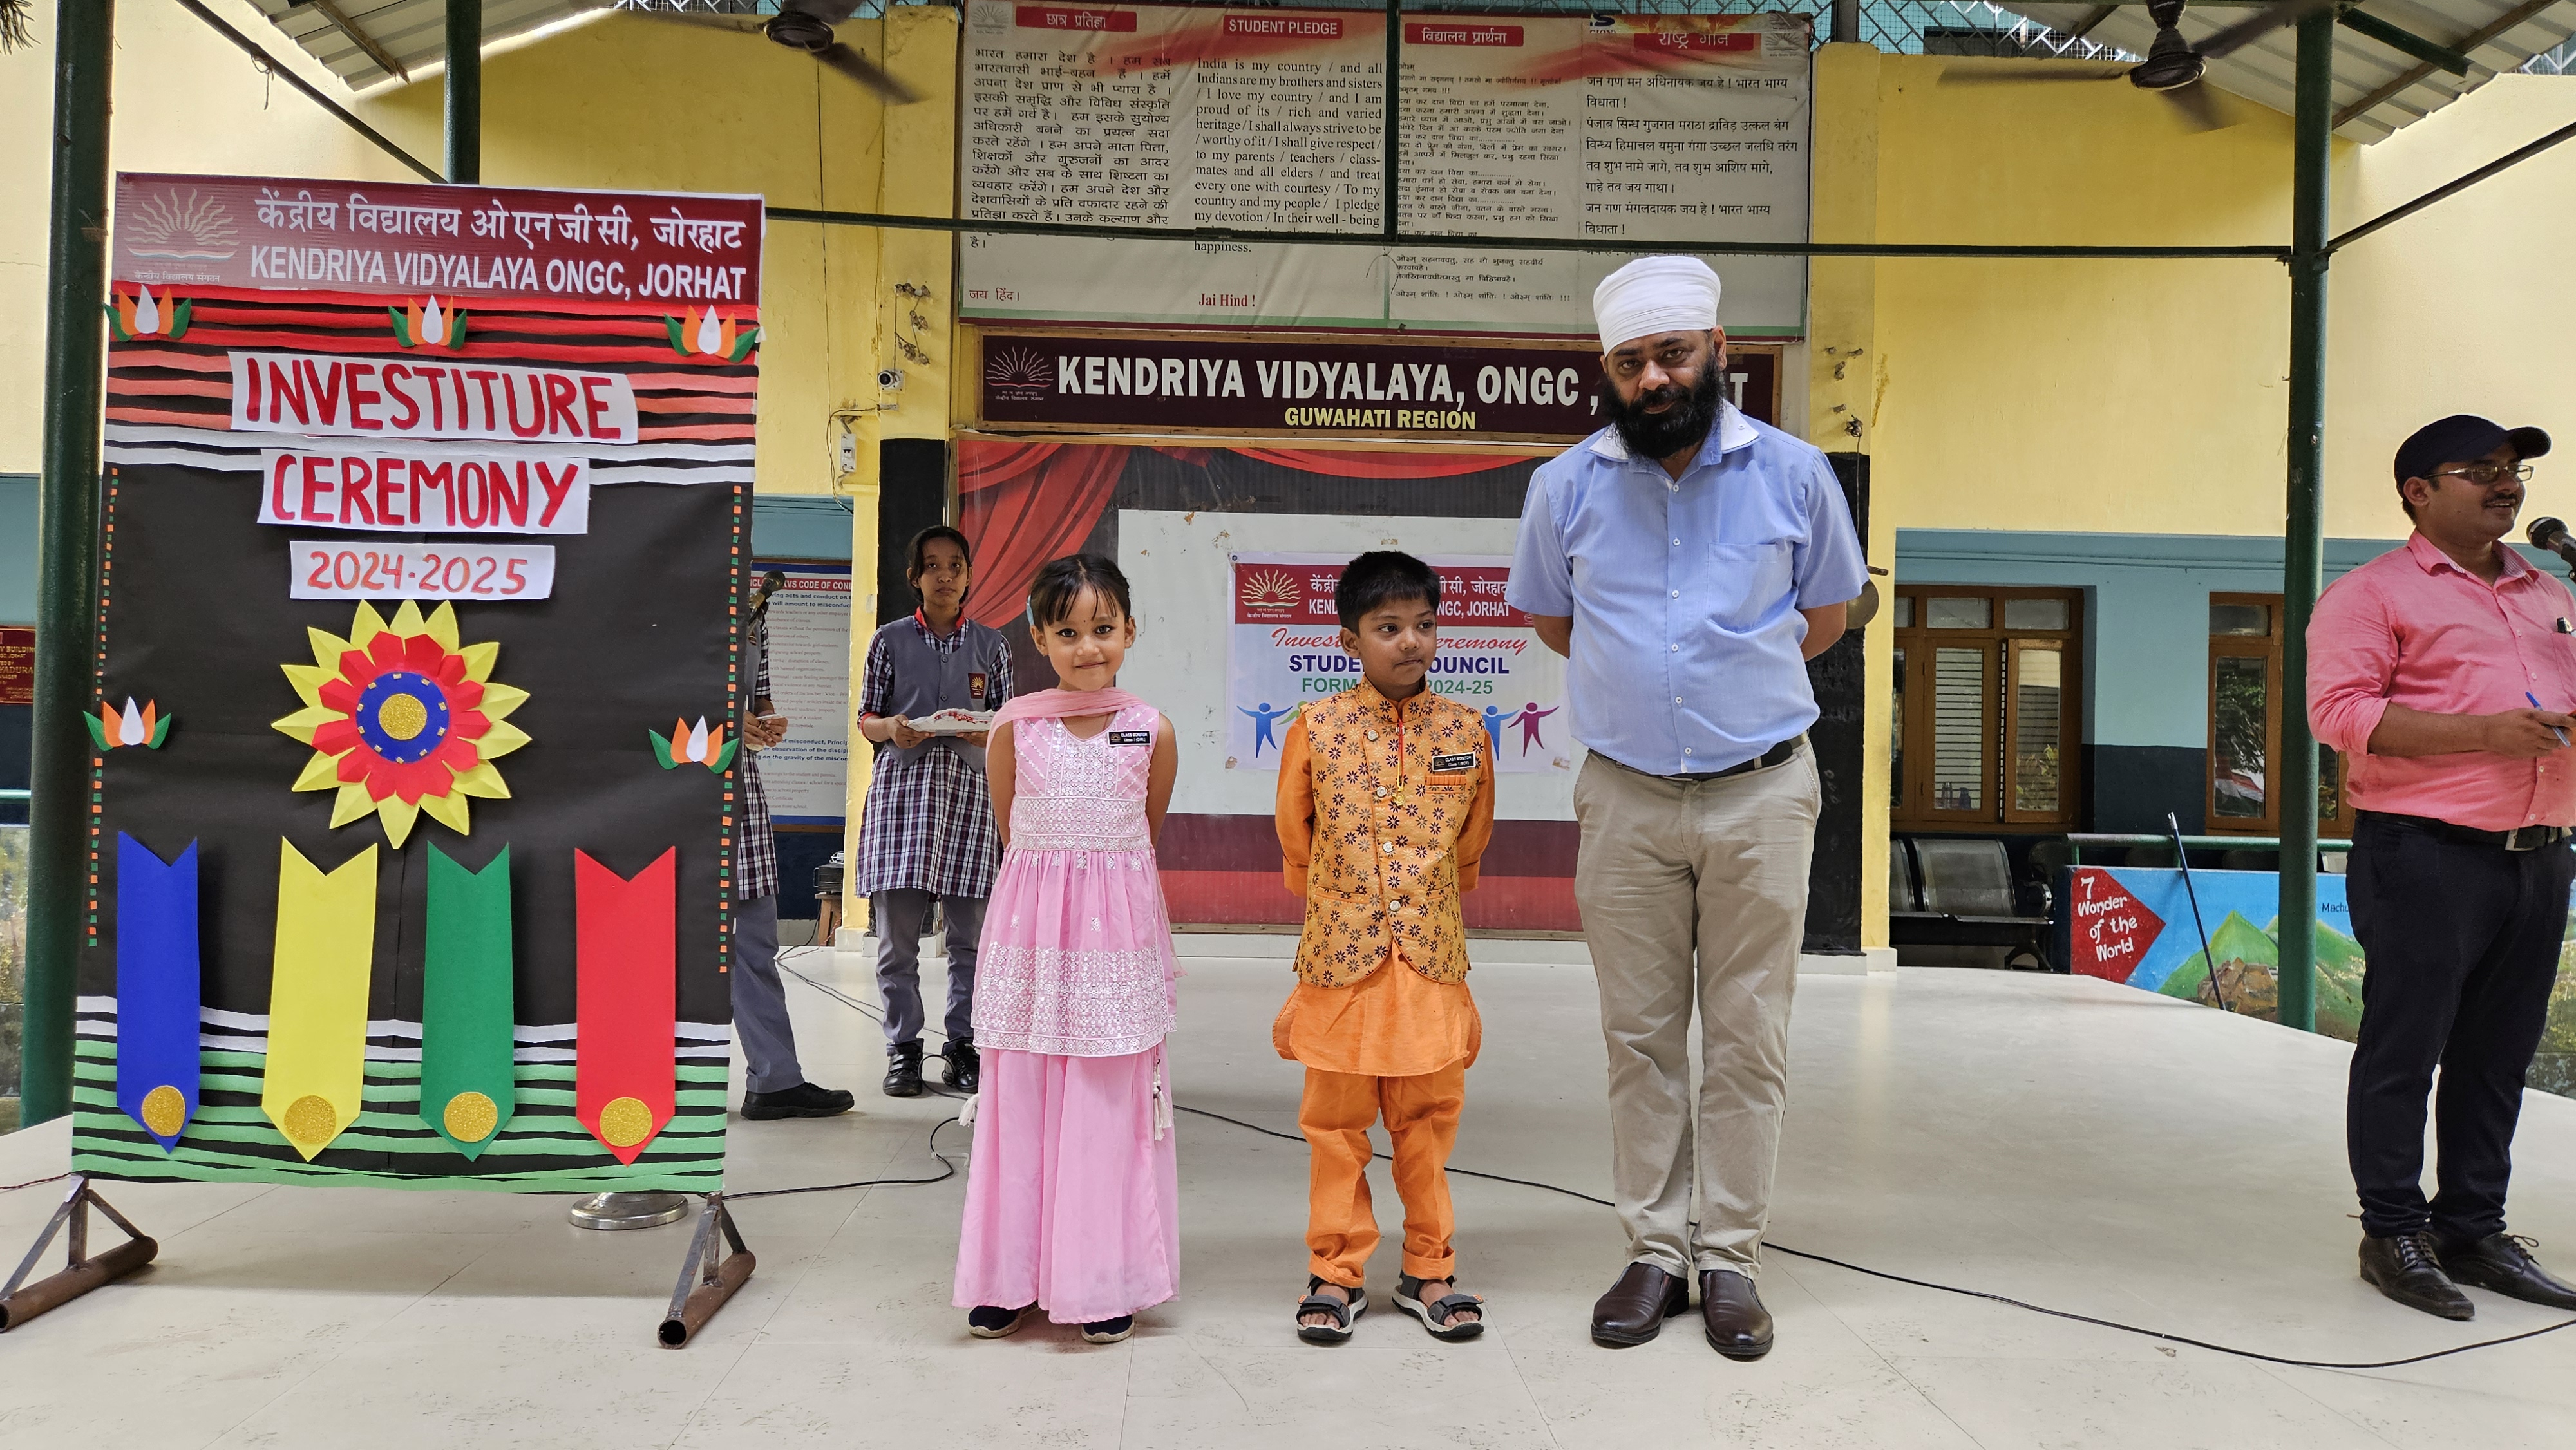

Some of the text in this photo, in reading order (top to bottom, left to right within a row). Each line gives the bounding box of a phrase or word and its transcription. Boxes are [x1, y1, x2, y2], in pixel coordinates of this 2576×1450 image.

[1046, 11, 1106, 29] छात्र प्रतिज्ञा
[1229, 19, 1338, 35] STUDENT PLEDGE
[1421, 27, 1507, 44] विद्यालय प्रार्थना
[1198, 72, 1382, 89] Indians are my brothers and sisters
[974, 91, 1171, 112] इसकी समृद्धि और विविध संस्कृति
[1197, 104, 1229, 116] proud
[1237, 104, 1251, 115] of
[1257, 104, 1269, 116] its
[1289, 106, 1311, 117] rich
[1318, 107, 1338, 118] and
[1346, 108, 1381, 119] varied
[1197, 118, 1240, 133] heritage
[1249, 120, 1252, 131] I
[1255, 120, 1280, 131] shall
[1283, 121, 1321, 135] always
[1323, 122, 1354, 133] strive
[1356, 124, 1367, 134] to
[1368, 123, 1381, 135] be
[1586, 137, 1798, 154] विन्ध्य हिमाचल यमुना गंगा उच्छल जलधि तरंग
[972, 148, 1170, 167] शिक्षकों और गुरुजनों का आदर
[1195, 166, 1227, 175] mates
[1234, 165, 1253, 176] and
[1260, 166, 1273, 176] all
[1280, 166, 1313, 178] elders
[1330, 168, 1349, 179] and
[1356, 170, 1380, 180] treat
[1195, 182, 1226, 193] every
[1230, 183, 1251, 191] one
[1255, 181, 1279, 192] with
[1284, 184, 1331, 196] courtesy
[1343, 184, 1358, 194] To
[1363, 187, 1380, 198] my
[971, 192, 1168, 210] देशवासियों के प्रति वफादार रहने की
[1195, 197, 1236, 209] country
[1240, 196, 1260, 207] and
[1264, 199, 1281, 211] my
[1284, 197, 1320, 211] people
[1336, 198, 1339, 209] I
[1343, 198, 1380, 212] pledge
[254, 187, 339, 232] केंद्रीय
[346, 193, 463, 238] विद्यालय
[650, 205, 747, 254] जोरहाट
[1193, 241, 1252, 254] happiness.
[162, 271, 194, 281] विद्यालय
[196, 272, 220, 283] संगठन
[251, 245, 747, 301] KENDRIYA VIDYALAYA ONGC, JORHAT
[969, 290, 989, 300] जय
[1198, 293, 1216, 306] Jai
[1220, 294, 1248, 307] Hind
[1058, 355, 1246, 398] KENDRIYA
[1255, 359, 1466, 413] VIDYALAYA,
[1477, 365, 1580, 407] ONGC
[245, 356, 622, 440] INVESTITURE
[1284, 407, 1477, 430] GUWAHATI REGION
[271, 453, 580, 530] CEREMONY
[799, 580, 819, 589] CODE
[1309, 574, 1340, 594] केंद्री
[1437, 601, 1510, 619] NGC, JORHAT
[1436, 637, 1528, 656] eremony
[1289, 654, 1510, 674] STUDE OUNCIL
[2080, 876, 2095, 900] 7
[2078, 896, 2128, 918] Wonder
[2089, 916, 2138, 945] of the
[2096, 936, 2134, 963] World
